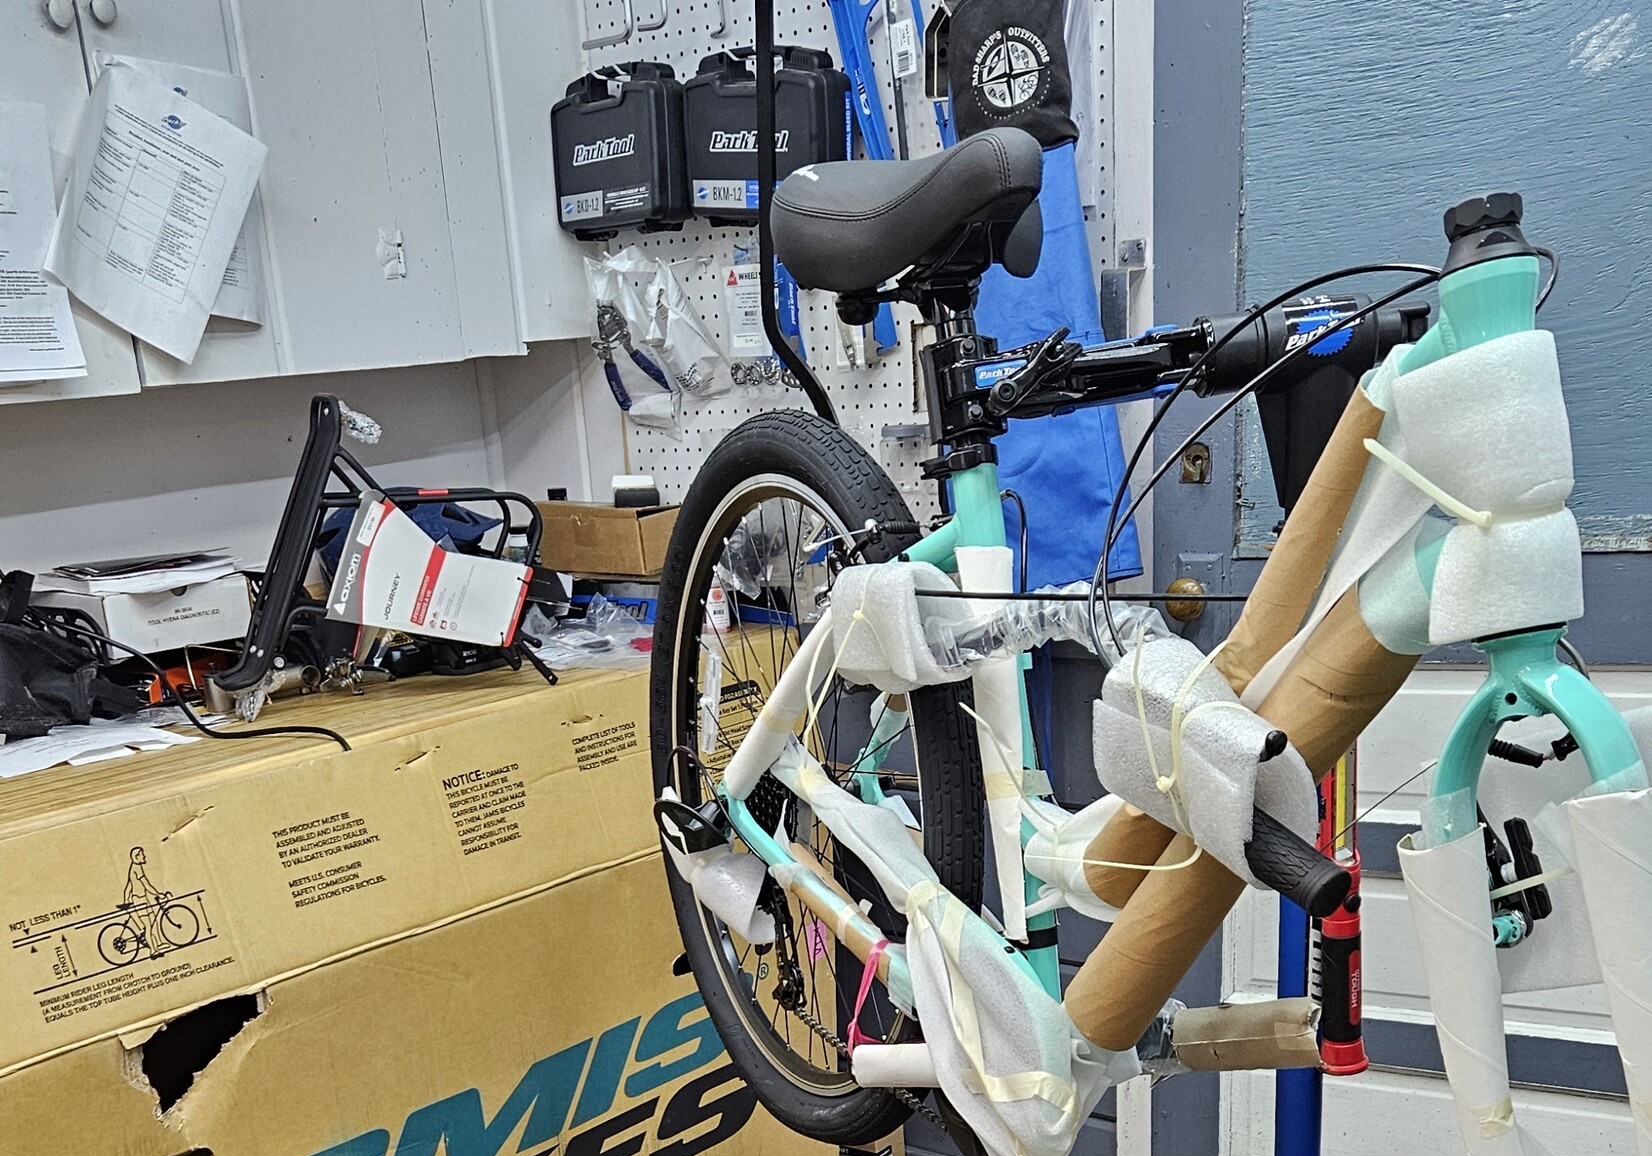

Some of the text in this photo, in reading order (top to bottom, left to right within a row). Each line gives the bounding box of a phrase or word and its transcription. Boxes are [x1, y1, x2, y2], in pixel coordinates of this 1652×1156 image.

[971, 30, 1002, 87] DAD SHARP'S
[1007, 26, 1050, 63] OUTFITTERS
[576, 197, 599, 214] BKD-1.2
[712, 186, 743, 201] BKM-1.2
[340, 553, 362, 601] axiom
[384, 572, 401, 620] JOURNEY
[572, 732, 600, 745] COMPLETE
[600, 728, 611, 738] LIST
[618, 721, 636, 732] TOOLS
[575, 731, 636, 754] AND INSTRUCTIONS FOR
[577, 750, 604, 763] ASSEMBLY
[604, 746, 617, 755] AND
[627, 740, 638, 748] ARE
[442, 763, 519, 791] NOTICE: DAMAGE TO
[446, 776, 509, 800] THIS BICYCLE MUST BE
[449, 781, 525, 809] REPORTED AT ONCE TO THE
[452, 790, 526, 819] CARRIER AND CLAIM MADE
[272, 811, 351, 839] THIS PRODUCT MUST BE
[454, 820, 464, 828] TO
[483, 809, 500, 819] JAMIS
[500, 800, 525, 814] BICYCLES
[458, 816, 507, 837] CANNOT ASSUME
[276, 818, 365, 848] ASSEMBLED AND ADJUSTED
[278, 828, 369, 859] BY AN AUTHORIZED DEALER
[460, 822, 519, 846] RESPONSIBILITY FOR
[463, 831, 522, 856] DAMAGE IN TRANSIT.
[281, 834, 380, 869] TO VALIDATE YOUR WARRANTY.
[288, 860, 363, 888] MEETS U.S. CONSUMER
[291, 872, 360, 898] SAFETY COMMISSION
[295, 875, 387, 908] REGULATIONS FOR BICYCLES.
[9, 921, 26, 932] NOT
[29, 914, 50, 926] LESS
[50, 909, 72, 922] THAN
[53, 962, 62, 980] LEG
[55, 946, 71, 978] LENGTH
[40, 973, 134, 1007] MINIMUM RIDER LEG LENGTH
[45, 956, 235, 1024] EQUALS THE TOP TUBE HEIGHT PLUS ONE INCH CLEARANCE.
[51, 991, 103, 1012] MEASUREMENT
[103, 985, 123, 998] FROM
[123, 976, 151, 992] CROTCH
[151, 973, 161, 983] TO
[160, 963, 192, 980] GROUND)
